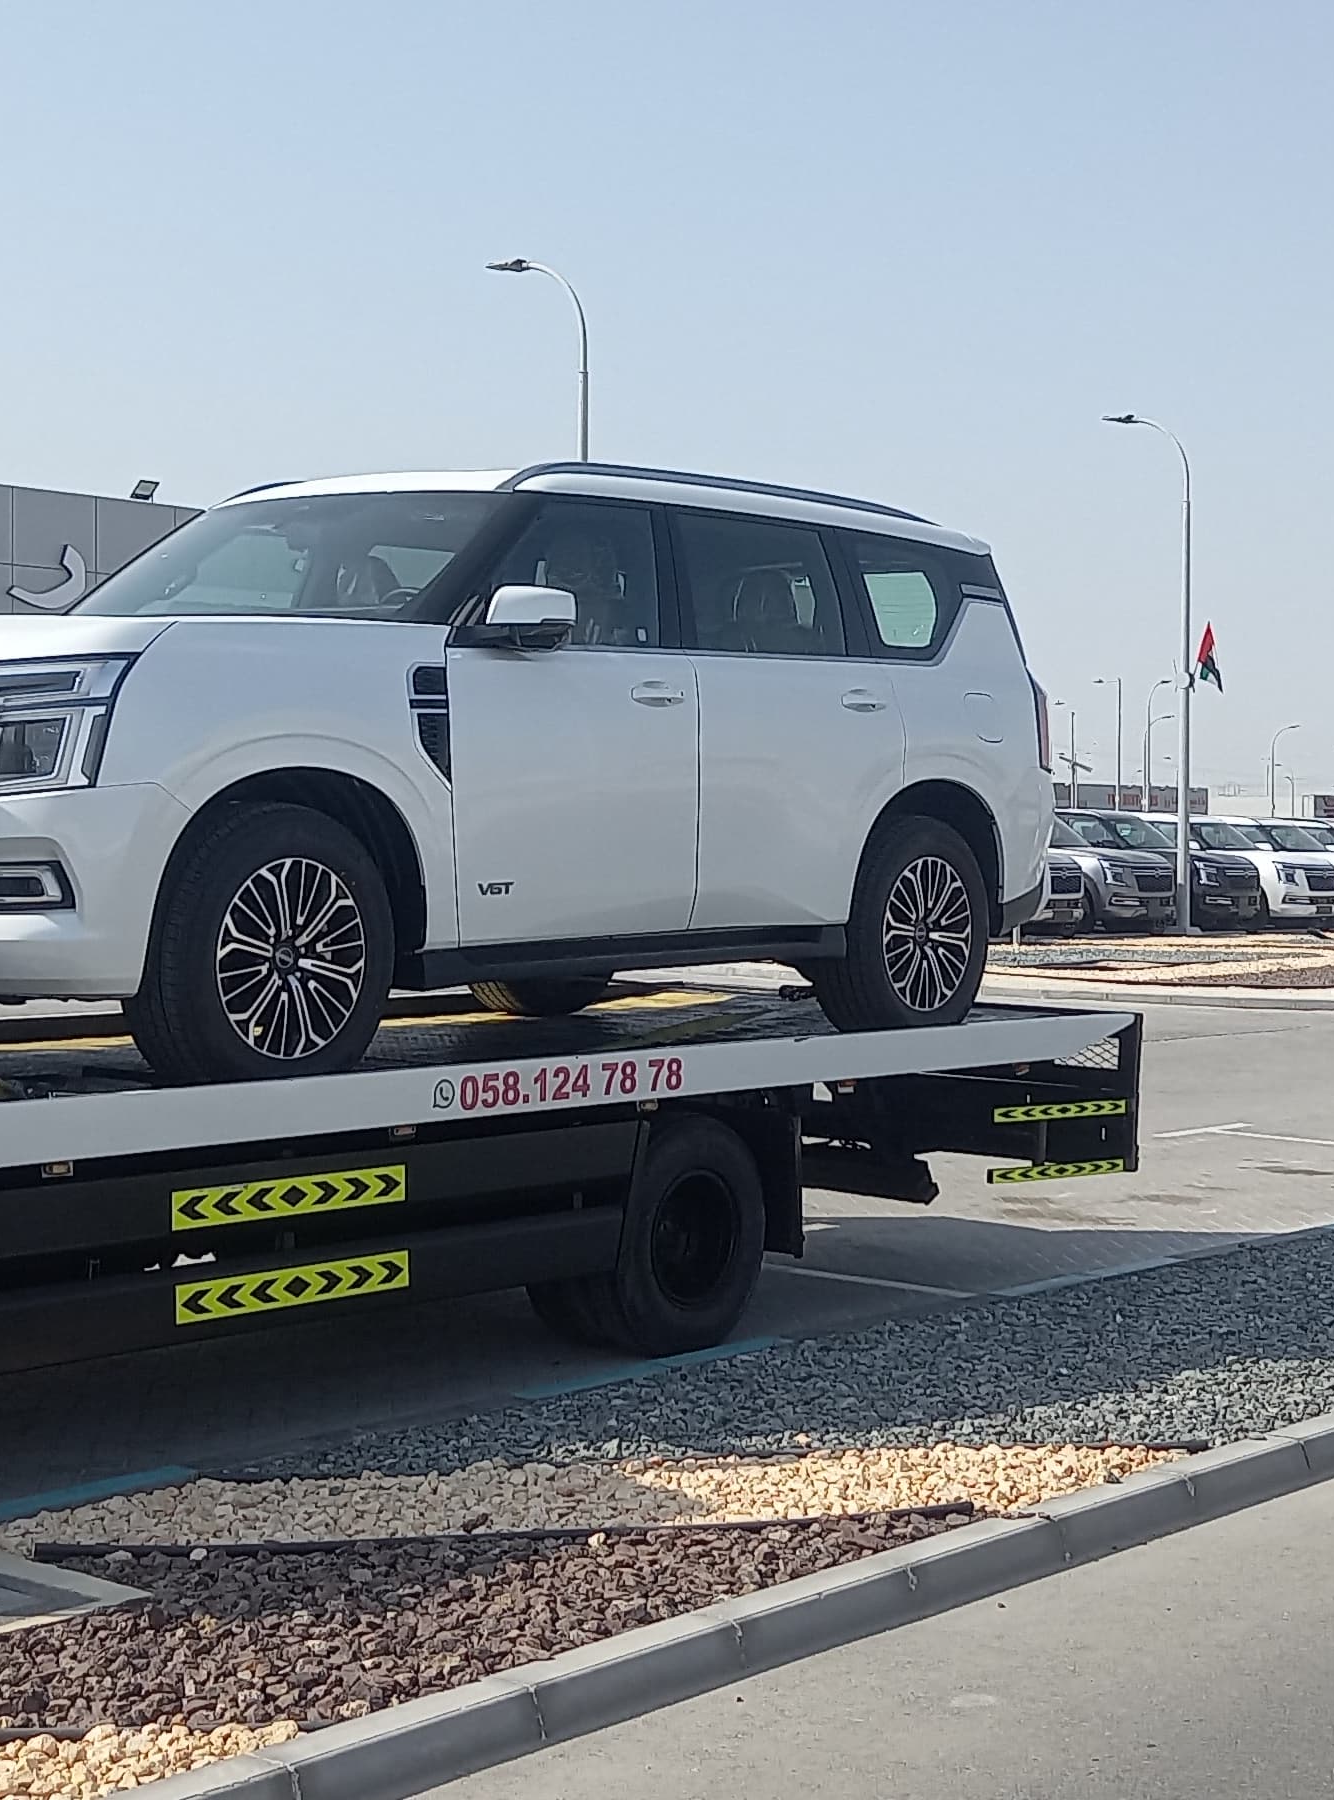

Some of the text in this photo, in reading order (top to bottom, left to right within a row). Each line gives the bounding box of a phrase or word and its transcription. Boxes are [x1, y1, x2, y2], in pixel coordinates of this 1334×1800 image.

[460, 1057, 684, 1111] 058.124 78 78
